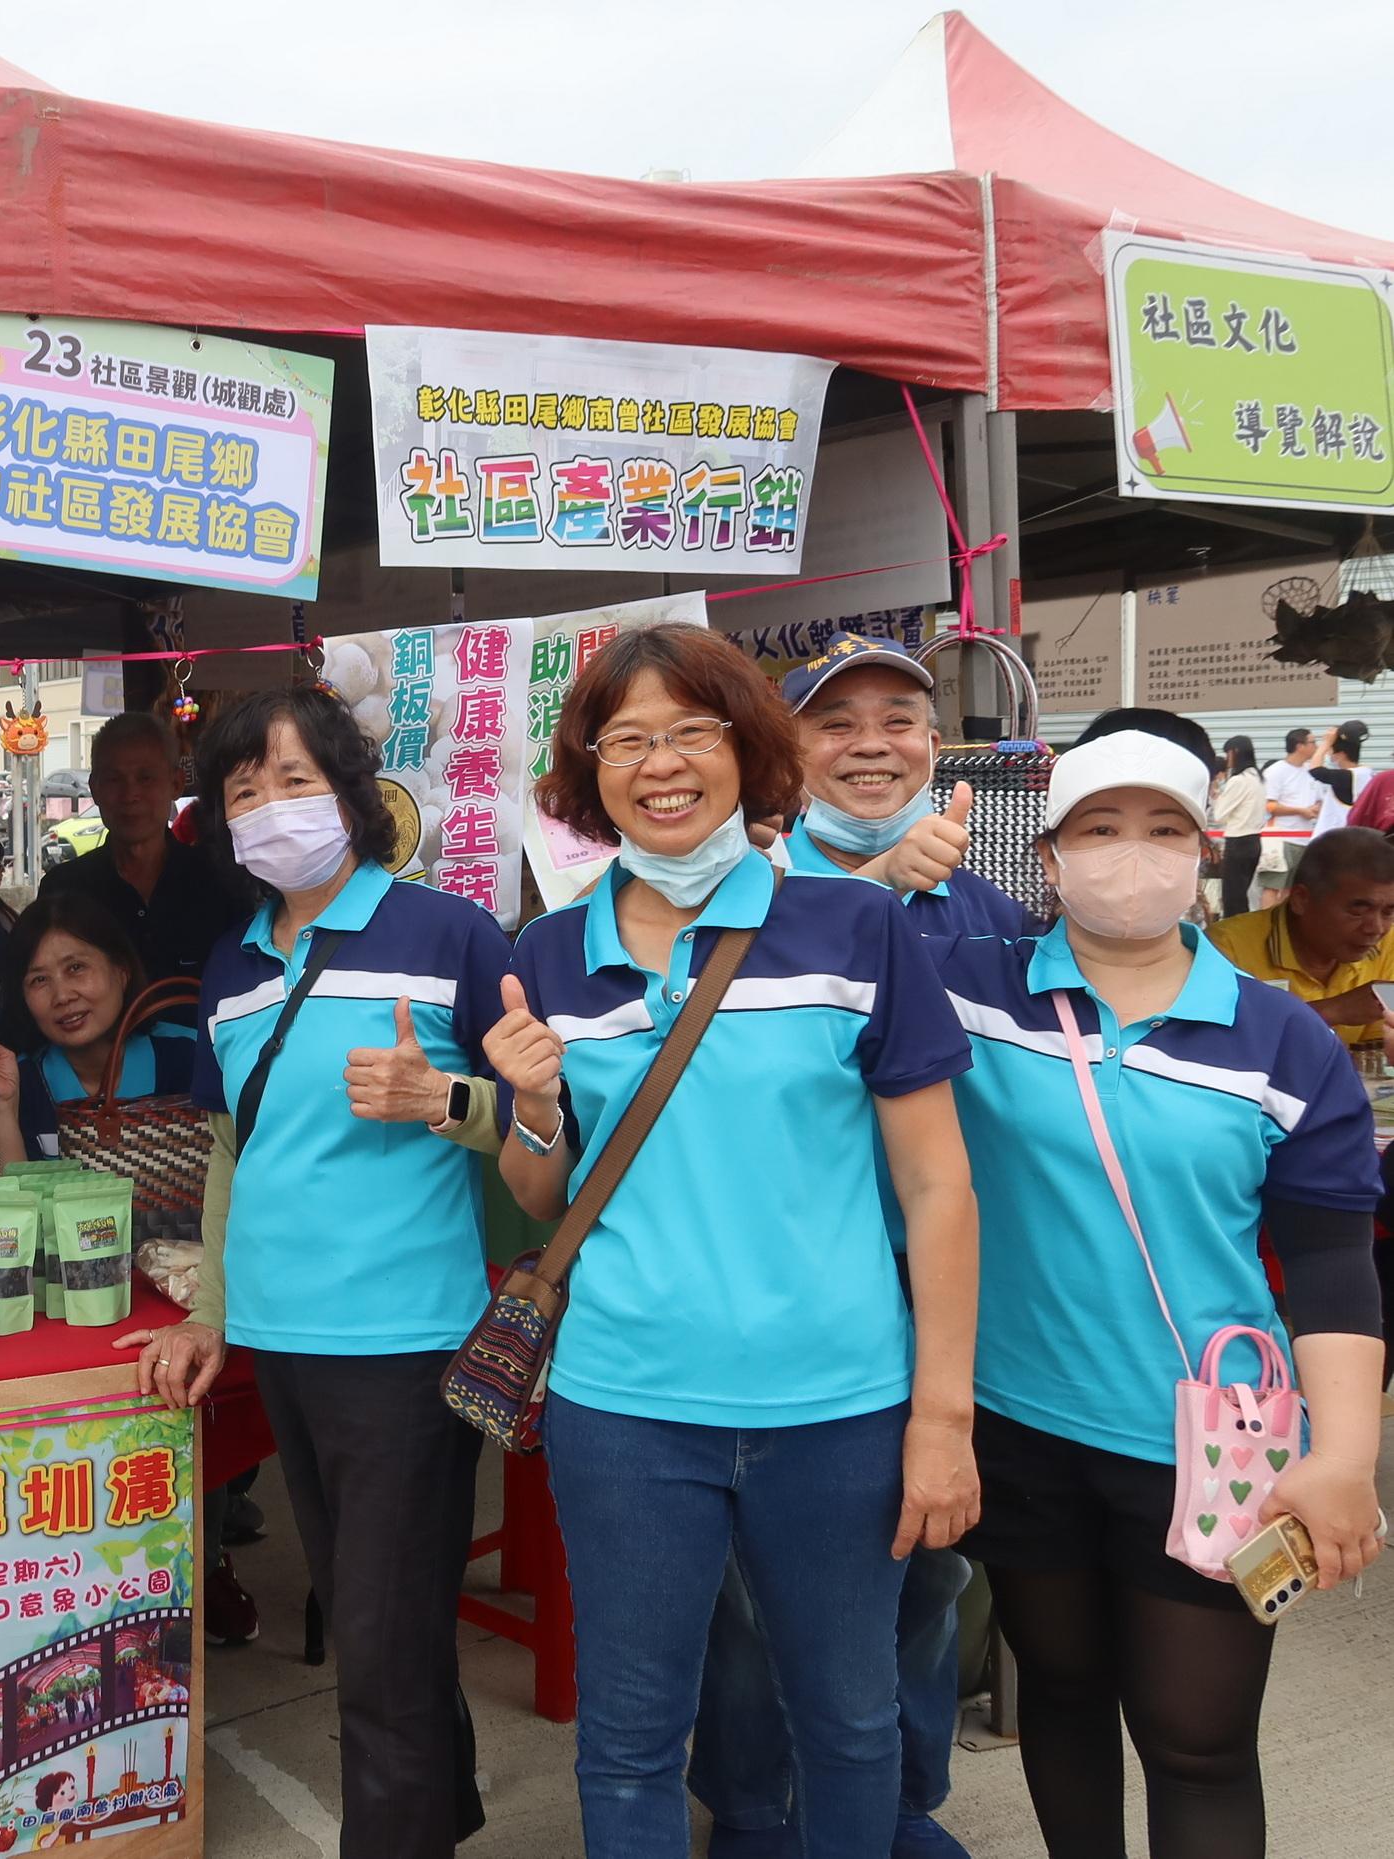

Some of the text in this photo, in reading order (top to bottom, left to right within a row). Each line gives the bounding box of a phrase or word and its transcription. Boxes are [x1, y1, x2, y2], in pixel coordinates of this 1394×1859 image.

[1141, 293, 1299, 356] 社區文化
[23, 329, 297, 418] 23 社區景觀(城觀處)
[416, 385, 800, 441] 彰化縣田尾鄉南曾社區發展協會
[1233, 399, 1386, 463] 導覽解說
[399, 447, 805, 553] 社區產業行銷
[382, 628, 437, 774] 銅板價
[438, 626, 512, 915] 健康養生菇
[565, 850, 589, 861] 100
